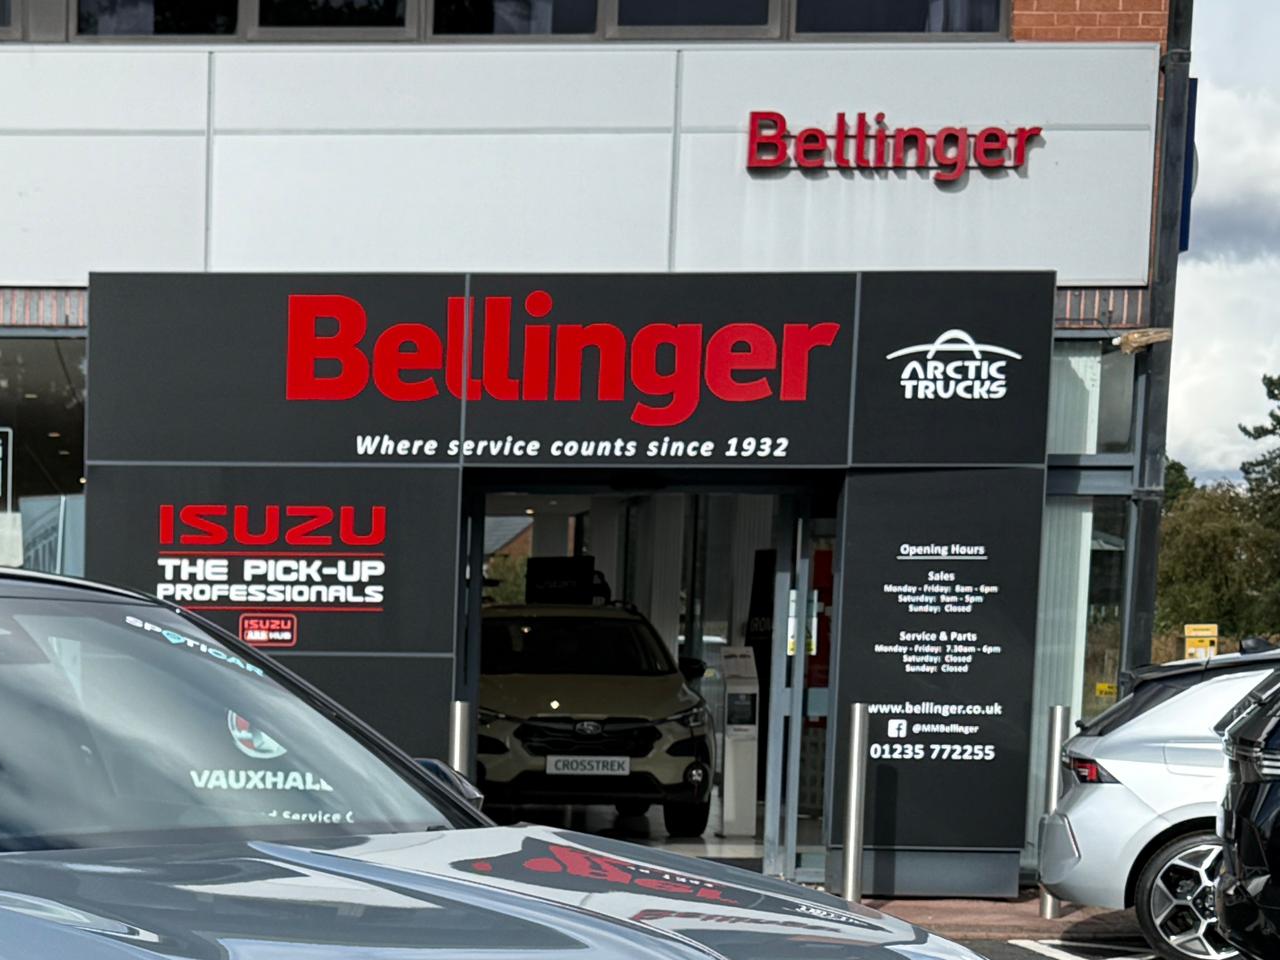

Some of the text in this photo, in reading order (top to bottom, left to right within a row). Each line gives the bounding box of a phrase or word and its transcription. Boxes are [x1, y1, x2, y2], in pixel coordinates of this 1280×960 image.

[746, 111, 1043, 182] Bellinger
[285, 290, 841, 427] Bellinger
[900, 360, 1007, 380] ARCTIC
[900, 380, 1007, 399] TRUCKS
[356, 434, 789, 457] Where service counts since 1932
[159, 504, 387, 546] ISUZU
[900, 544, 985, 556] Opening Hours
[157, 558, 385, 582] THE PICK-UP
[928, 571, 956, 581] Sales
[157, 583, 384, 602] PROFESSIONALS
[884, 584, 917, 594] Monday
[898, 594, 936, 604] Saturday:
[908, 604, 972, 614] Sunday: Closed
[244, 619, 291, 629] ISUZU
[899, 631, 978, 641] Service & Parts
[874, 644, 908, 654] Monday
[902, 654, 972, 664] Saturday: Closed
[905, 664, 969, 673] Sunday: Closed
[868, 701, 1003, 717] www.bellinger.co.uk
[912, 723, 980, 735] @MMBellinger
[870, 743, 995, 760] 01235 772255
[554, 759, 625, 772] CROSSTREK
